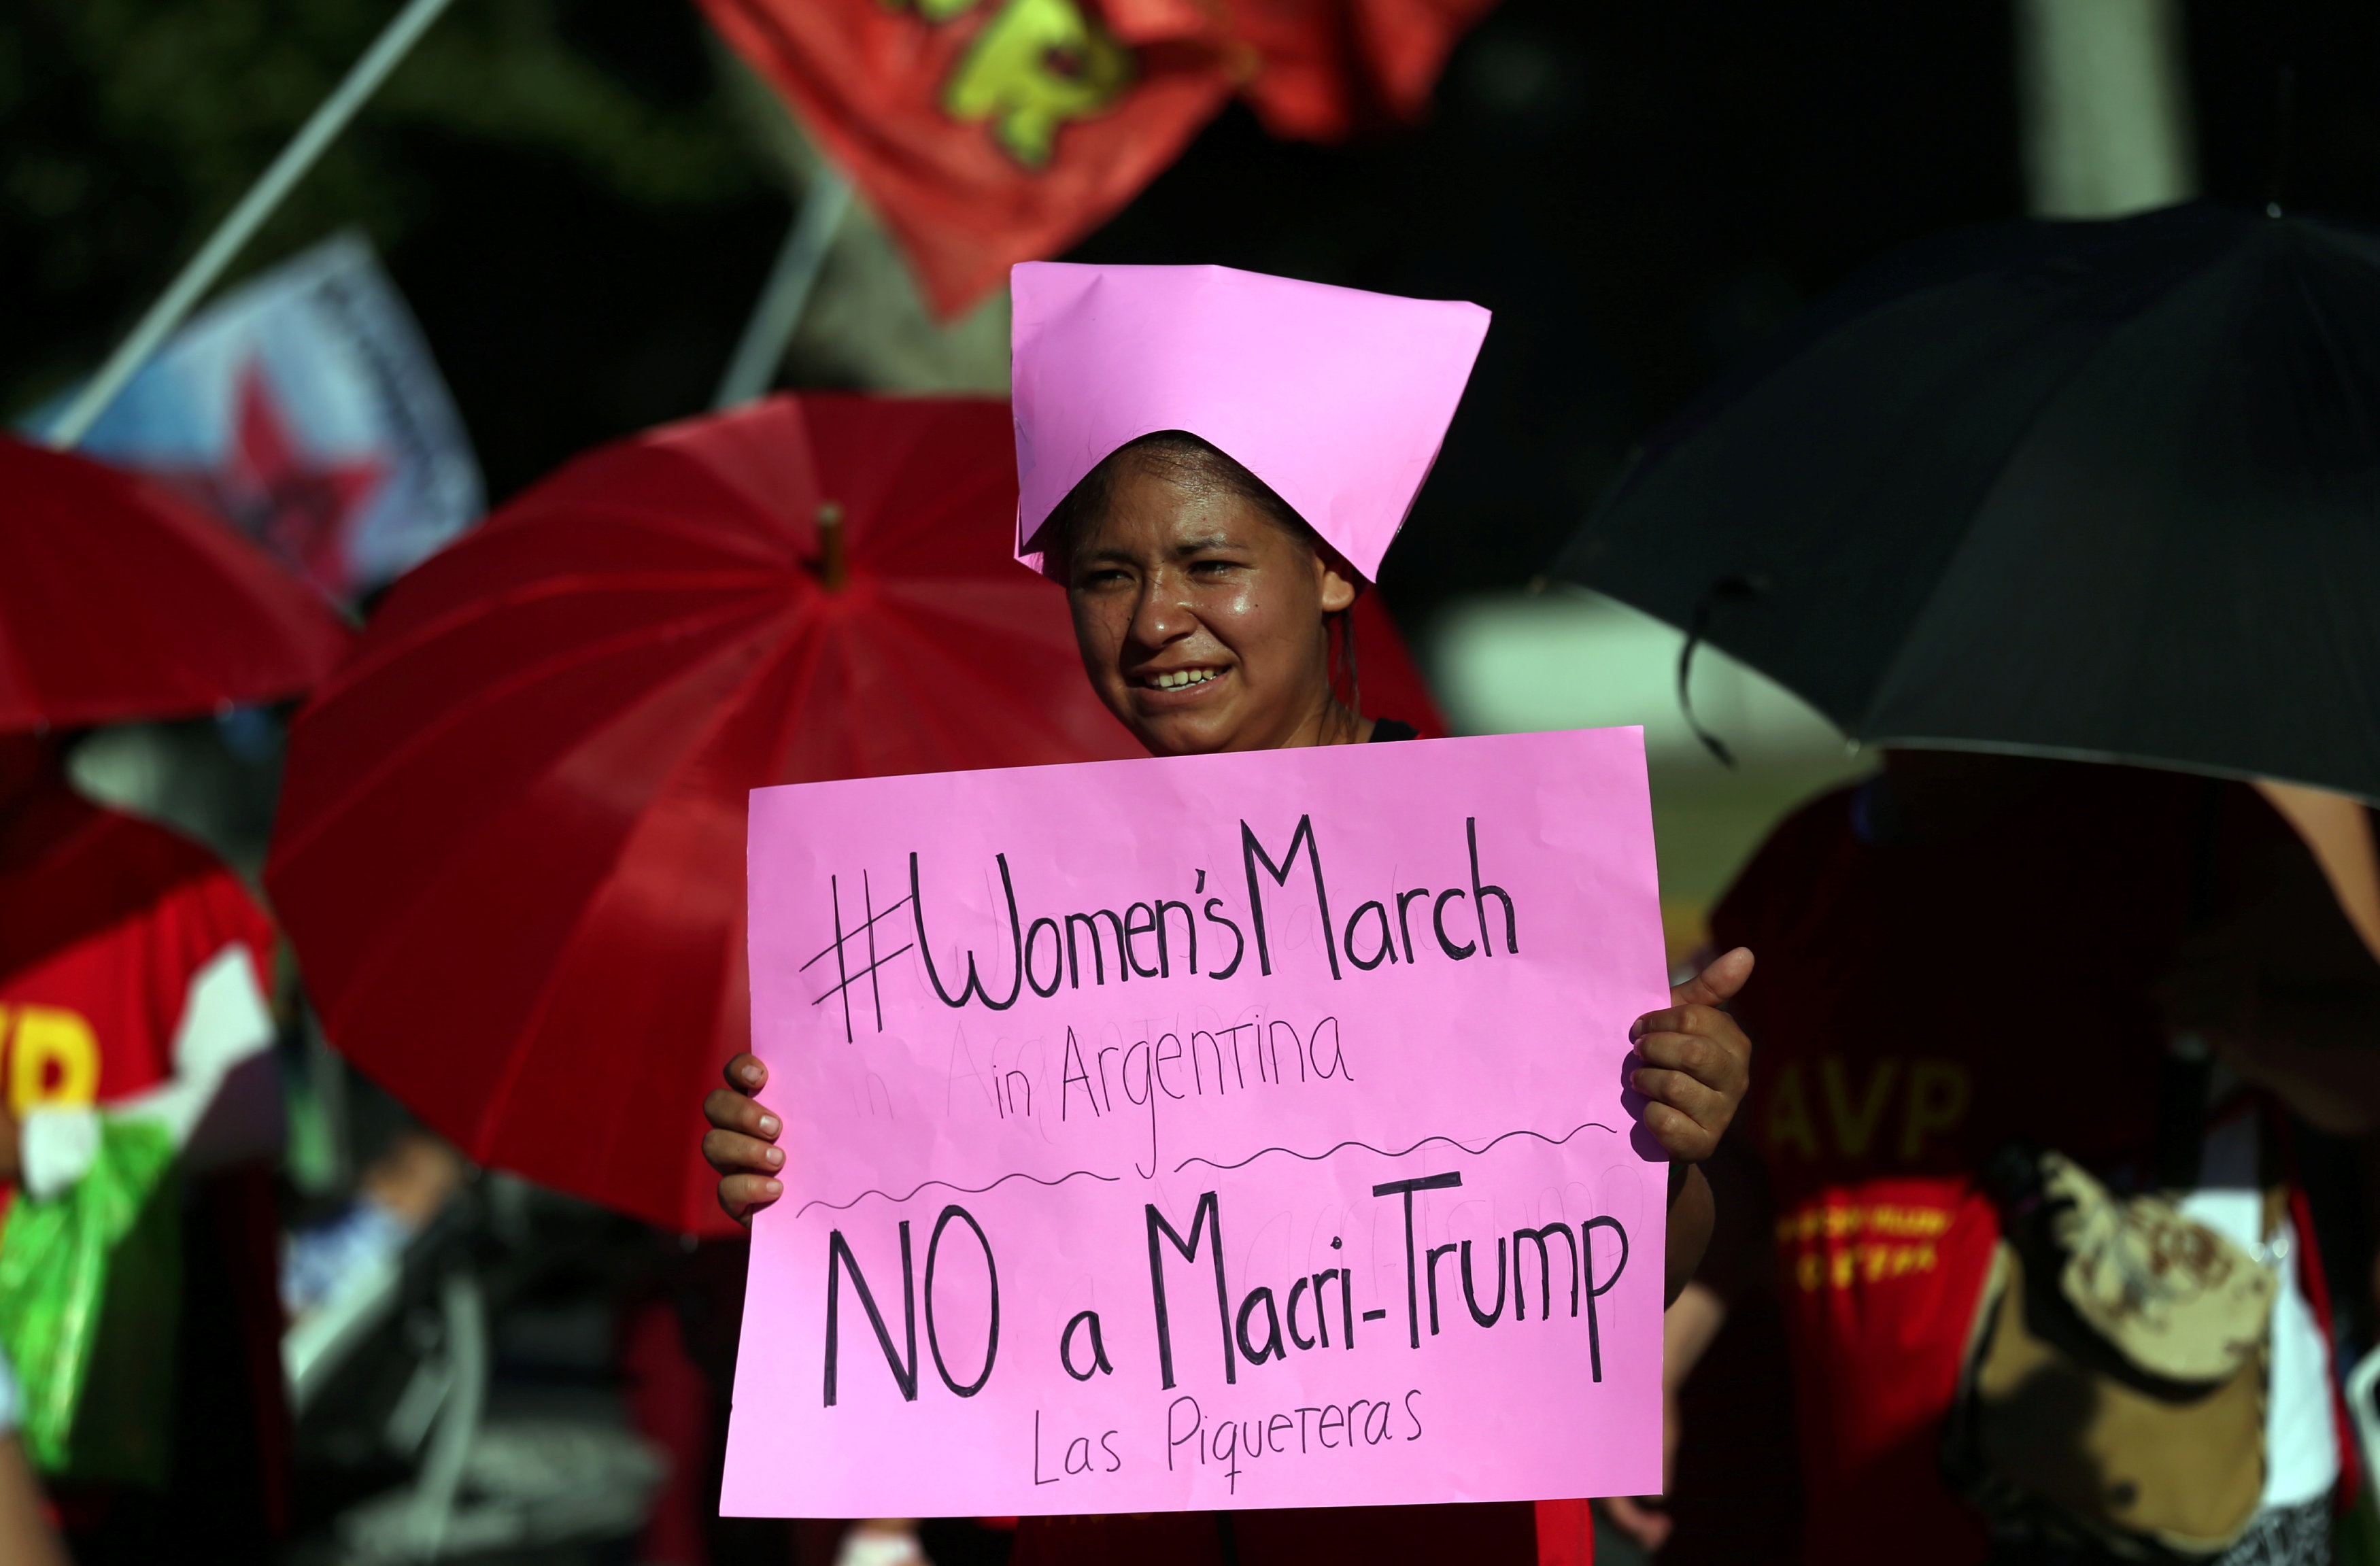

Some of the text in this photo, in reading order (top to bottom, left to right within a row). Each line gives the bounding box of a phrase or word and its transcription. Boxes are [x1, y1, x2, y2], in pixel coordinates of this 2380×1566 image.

[993, 1063, 1032, 1120] in
[1061, 1016, 1355, 1180] Argentina
[1767, 1054, 1971, 1159] AVP
[823, 1204, 1000, 1409] NO
[1059, 1310, 1114, 1382] a
[1034, 1389, 1423, 1495] Las Piqueteras
